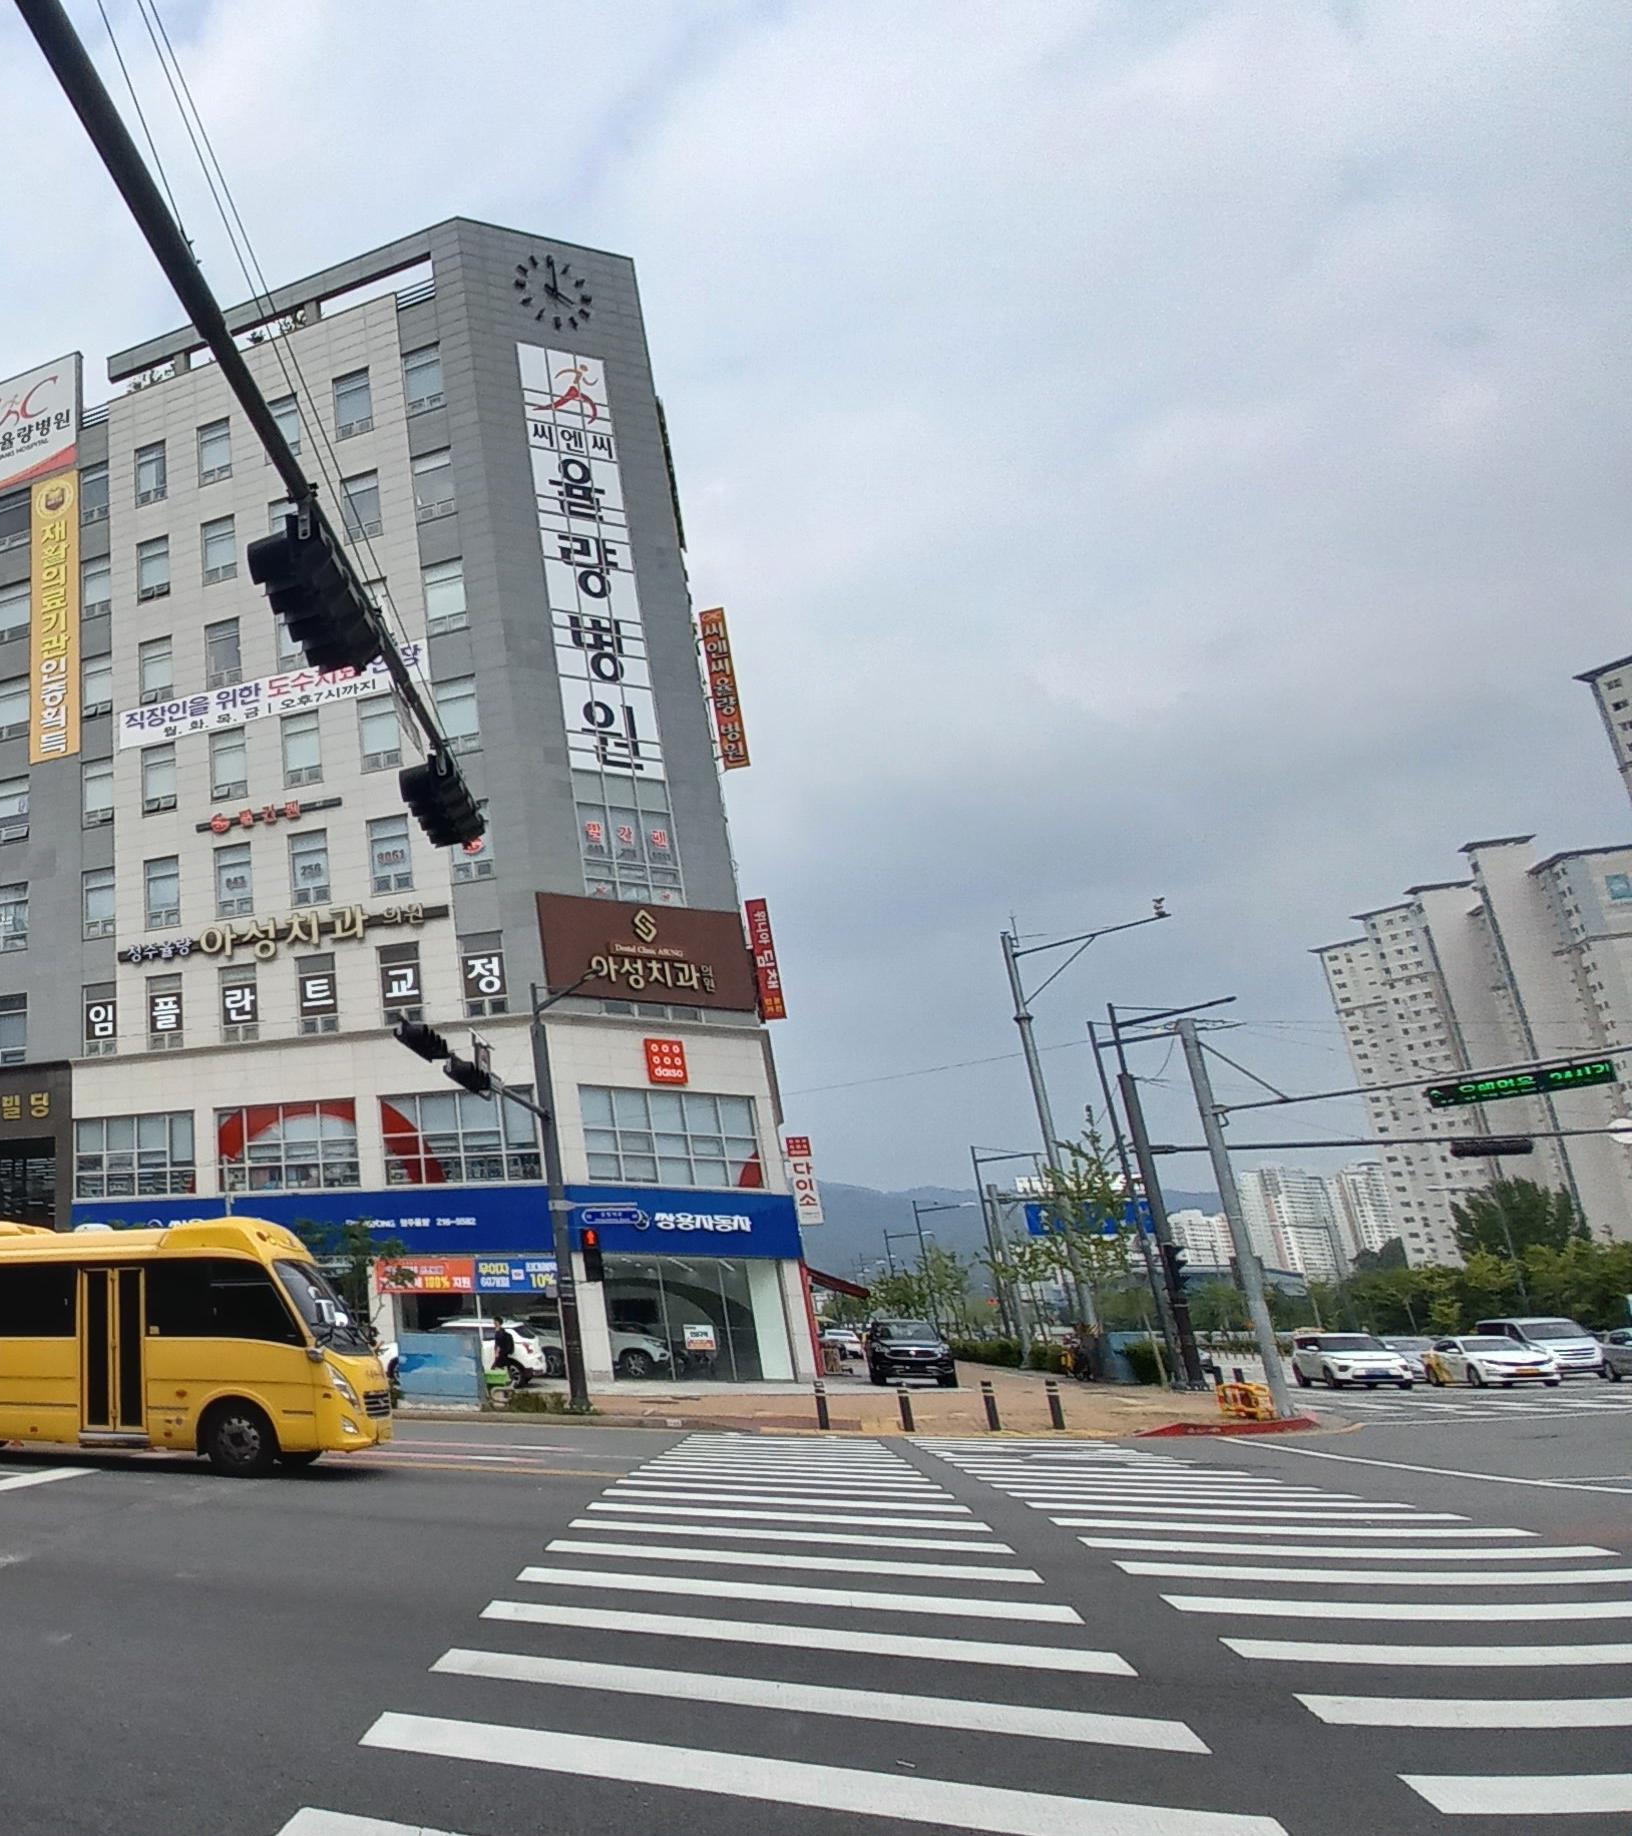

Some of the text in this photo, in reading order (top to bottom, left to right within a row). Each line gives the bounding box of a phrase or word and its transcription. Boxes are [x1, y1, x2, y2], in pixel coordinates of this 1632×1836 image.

[533, 423, 613, 460] 씨엔씨
[549, 458, 644, 772] 율량병원
[125, 694, 210, 730] 직장인을
[216, 682, 262, 711] 위한
[199, 903, 369, 961] 아성치과
[382, 902, 424, 926] 의원
[591, 956, 700, 990] 아성치과
[701, 964, 716, 993] 의원
[757, 950, 780, 990] 딤채
[793, 1162, 818, 1206] 다이소
[654, 1211, 752, 1233] 쌍용자동차
[424, 1276, 450, 1289] 100%
[530, 1273, 557, 1288] 10%
